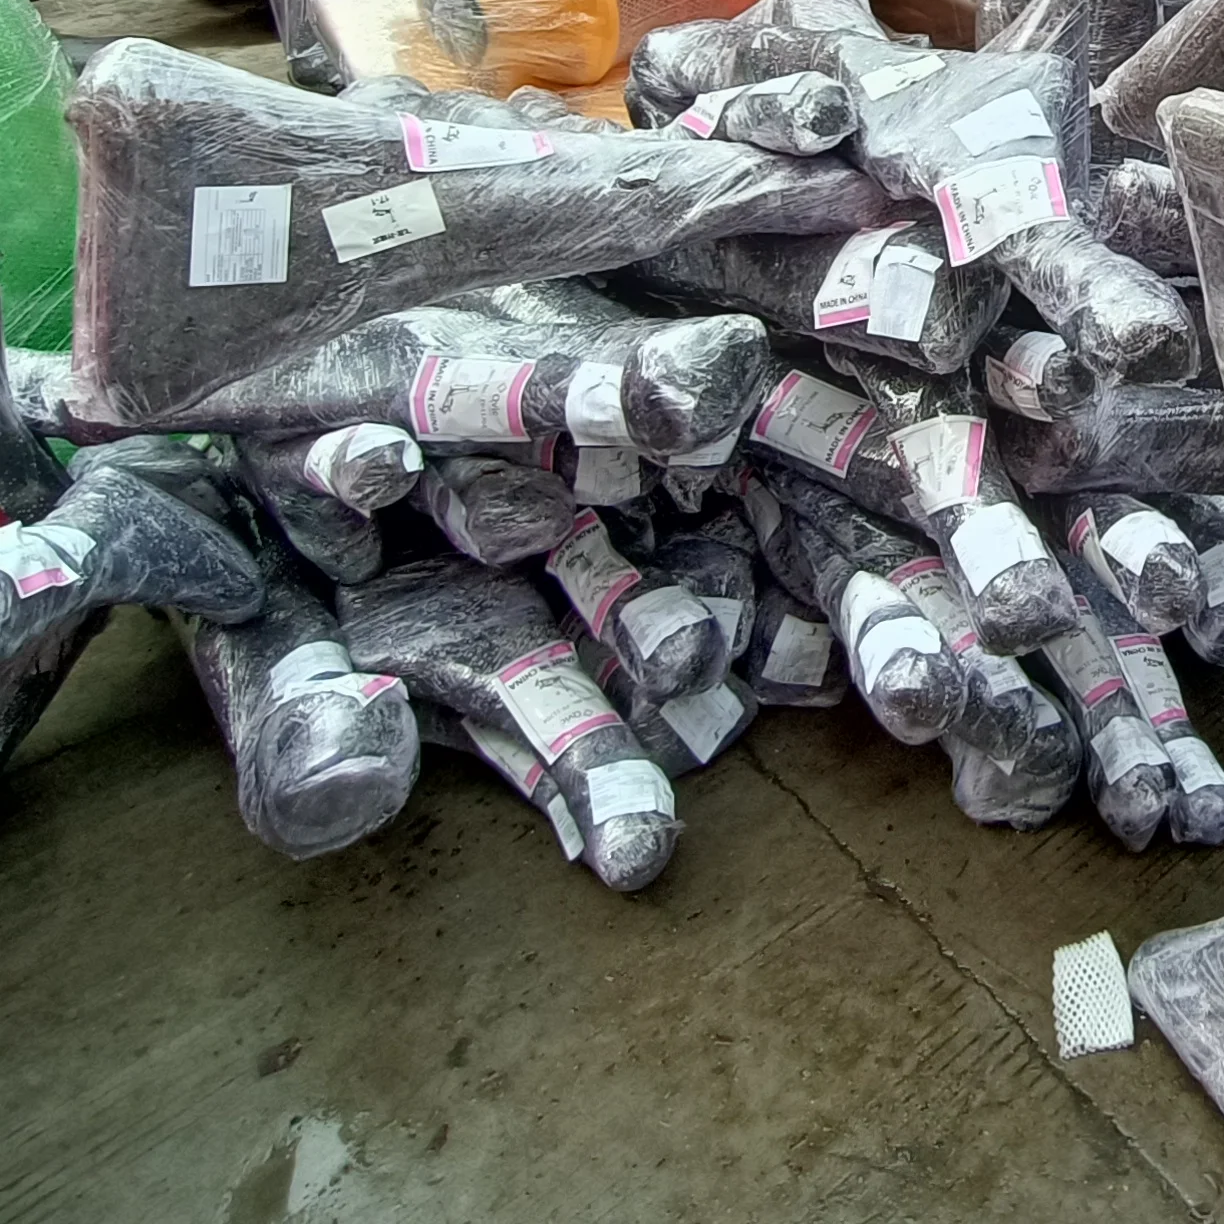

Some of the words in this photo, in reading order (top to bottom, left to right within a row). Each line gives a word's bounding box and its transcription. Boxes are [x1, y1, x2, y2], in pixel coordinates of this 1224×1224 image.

[424, 134, 438, 165] CHINA
[371, 195, 390, 206] 17-1
[950, 183, 963, 210] MADE
[959, 211, 968, 223] IN
[961, 223, 976, 253] CHINA
[820, 298, 839, 310] MADE
[840, 298, 847, 306] IN
[848, 293, 868, 304] CHINA
[433, 359, 450, 389] MADE
[428, 390, 437, 402] IN
[427, 403, 440, 433] CHINA
[825, 437, 843, 463] MADE
[839, 425, 849, 437] IN
[508, 668, 538, 690] CHINA
[560, 709, 581, 725] Qvic
